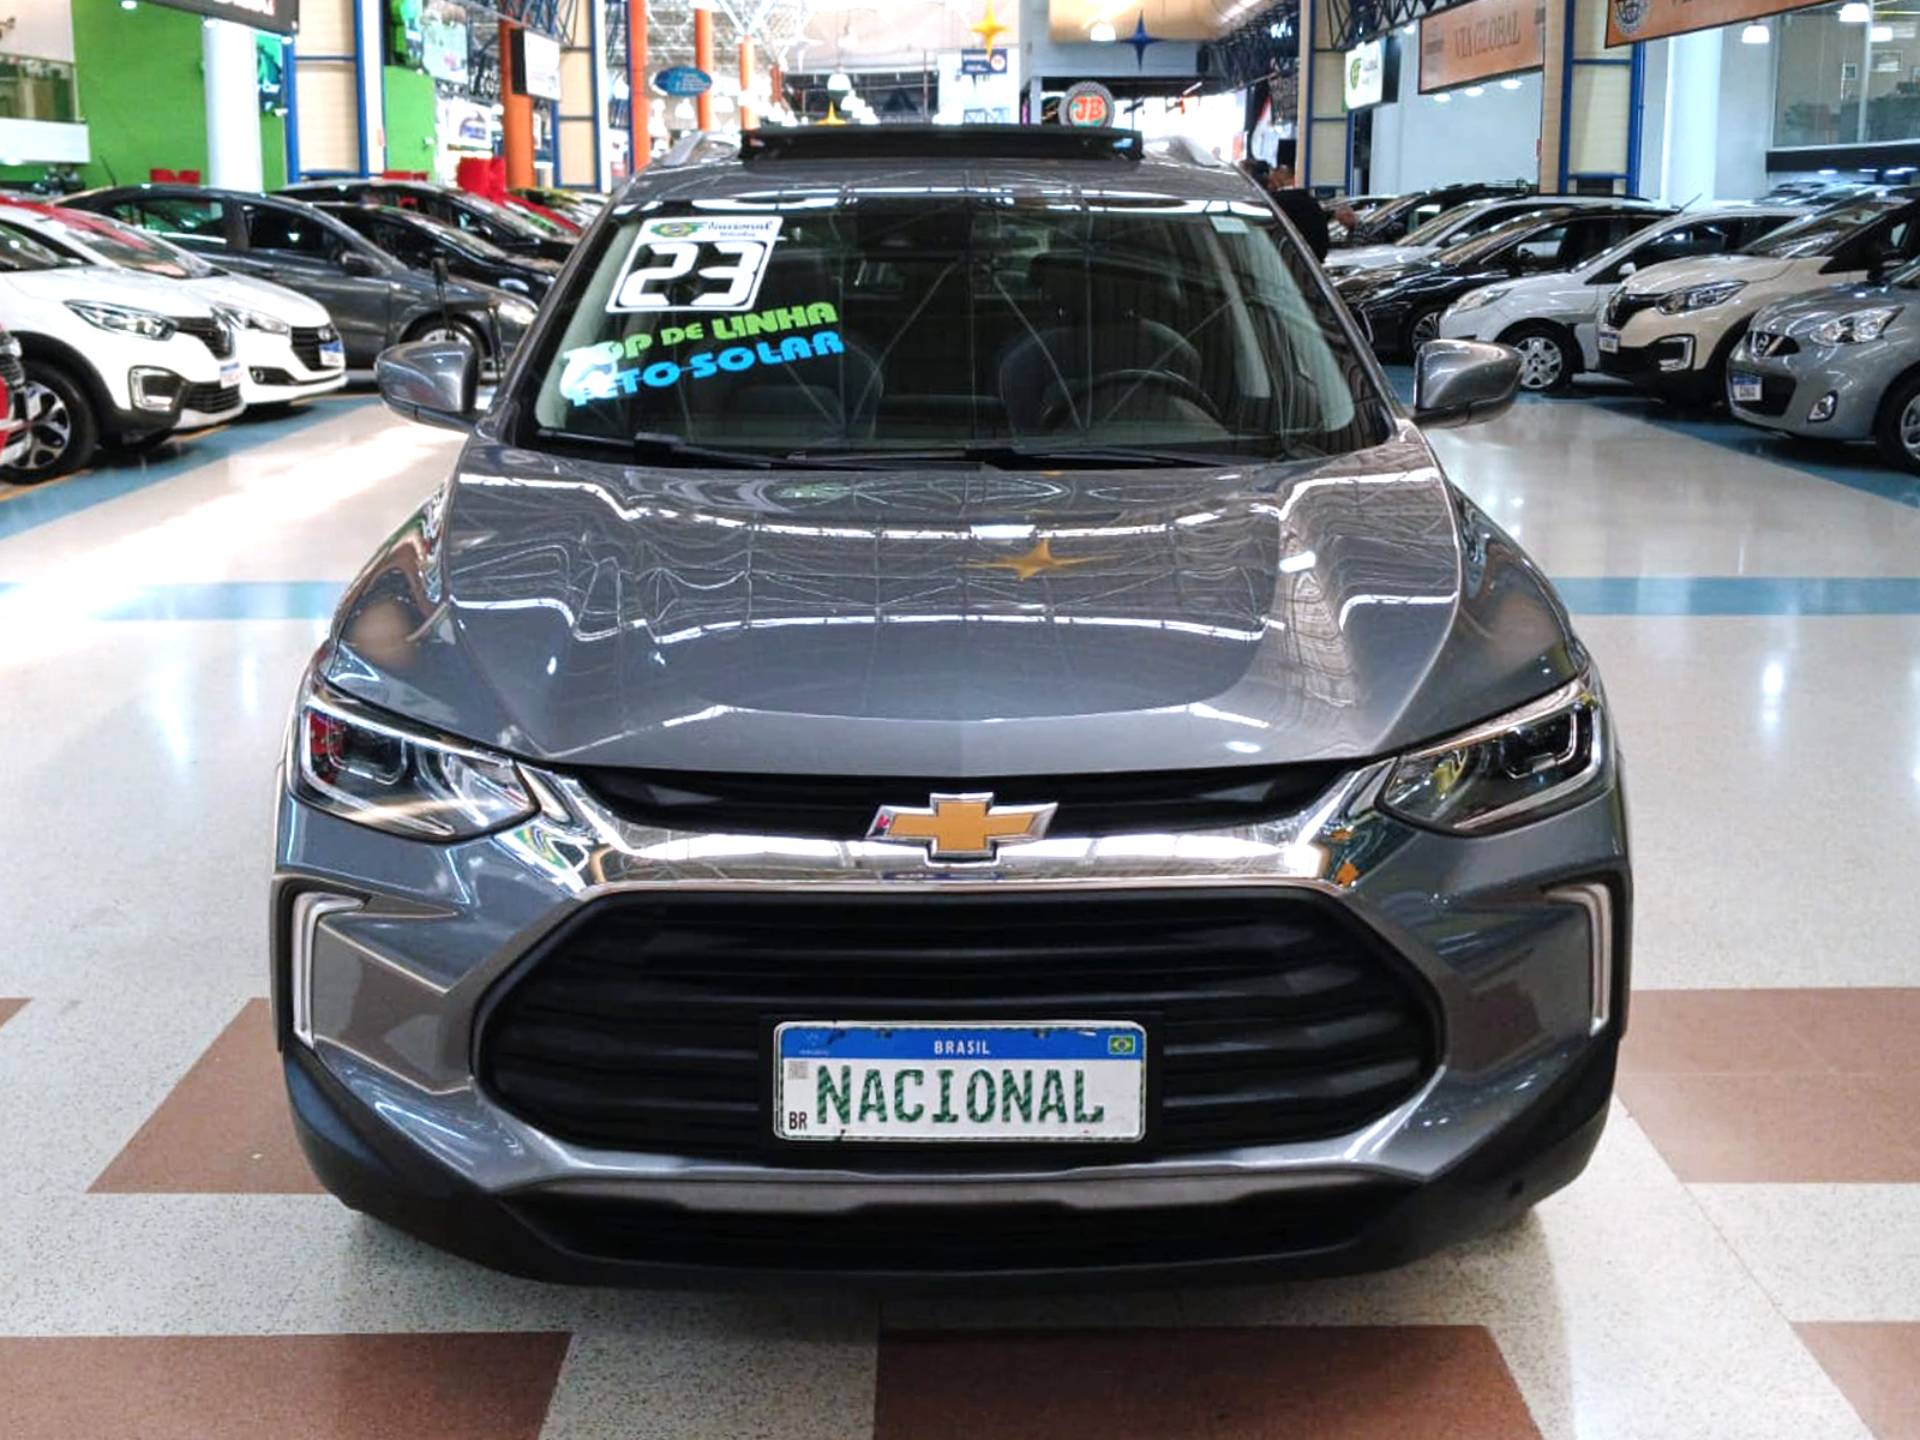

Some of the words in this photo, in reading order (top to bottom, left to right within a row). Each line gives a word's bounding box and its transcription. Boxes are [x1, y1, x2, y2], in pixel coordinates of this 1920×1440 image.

[1072, 94, 1105, 122] JB
[618, 241, 764, 307] 23
[660, 322, 704, 347] DE
[713, 302, 838, 340] LINHA
[691, 331, 844, 379] SOLAR
[933, 1040, 991, 1056] BRASIL
[815, 1064, 1105, 1126] NACIONAL
[788, 1110, 808, 1131] BR
